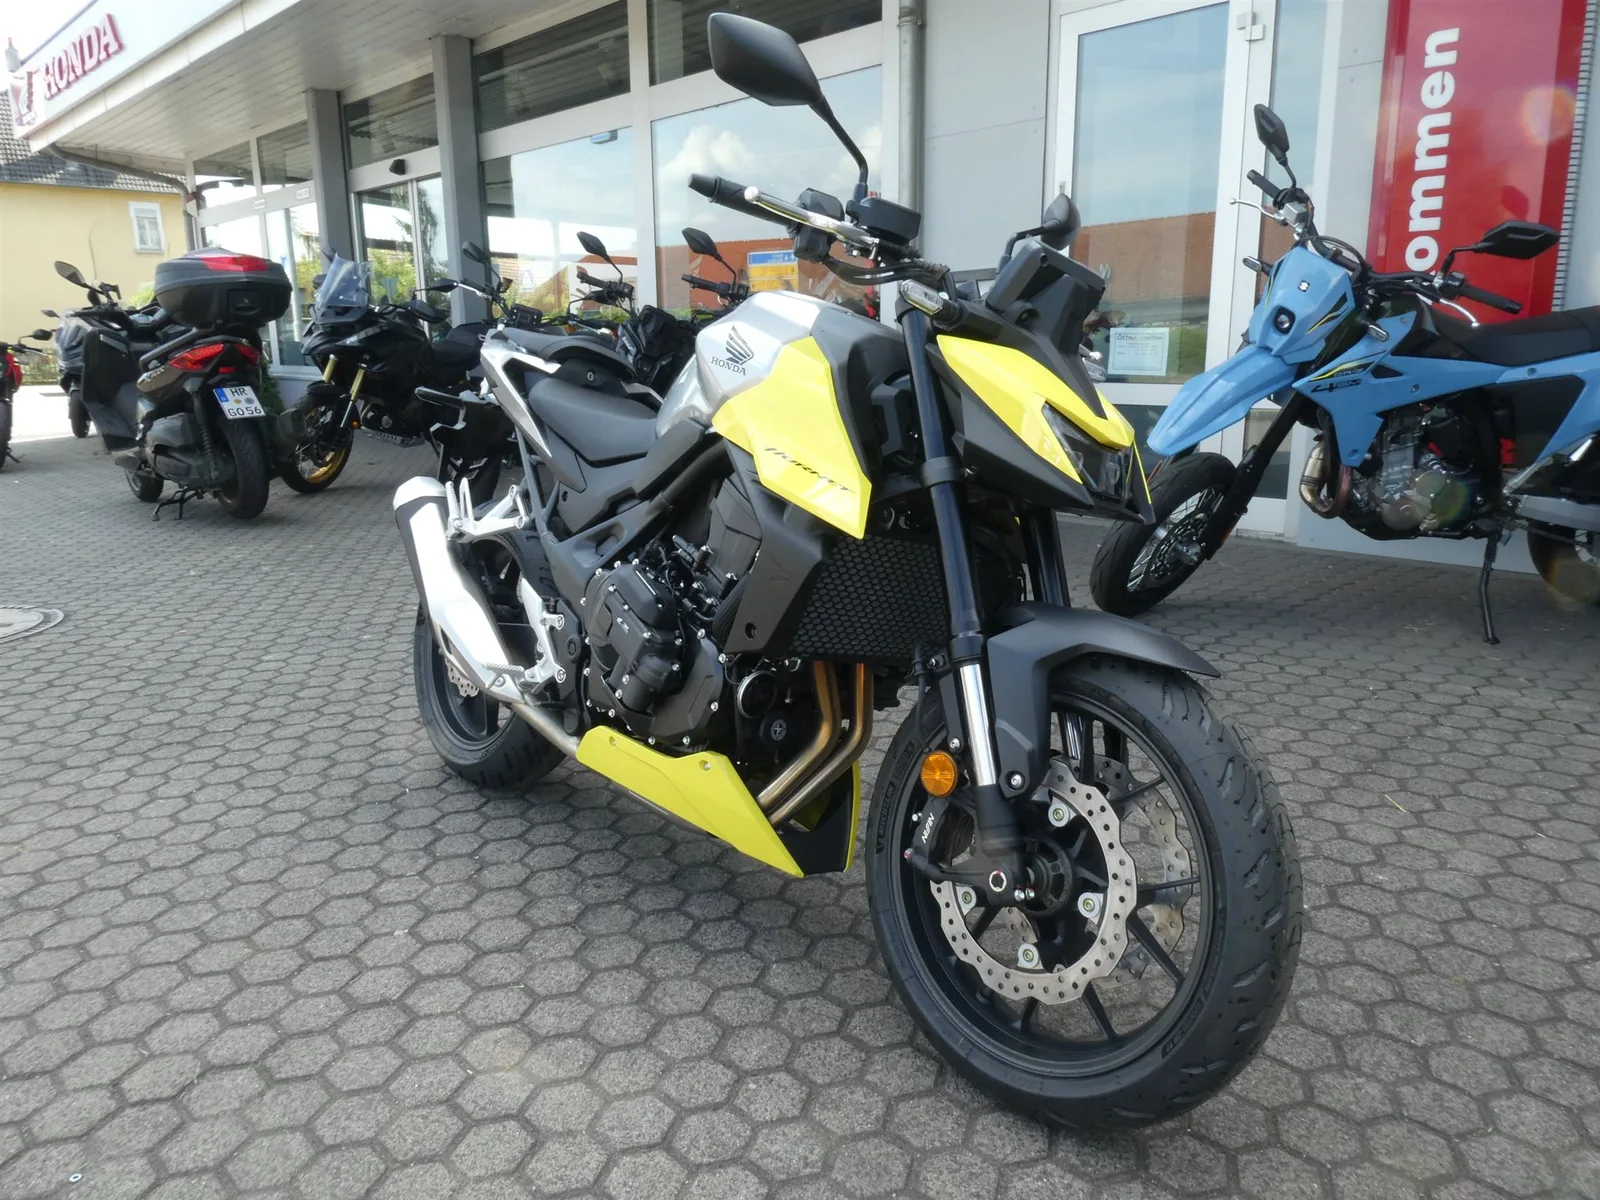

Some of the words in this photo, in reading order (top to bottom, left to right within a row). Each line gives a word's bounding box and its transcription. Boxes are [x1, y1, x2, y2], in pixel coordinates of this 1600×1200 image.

[44, 13, 124, 100] HONDA
[1405, 28, 1460, 276] ommen
[711, 356, 747, 377] HONDA
[229, 388, 248, 398] HR
[228, 407, 244, 417] GO
[247, 405, 262, 415] 56
